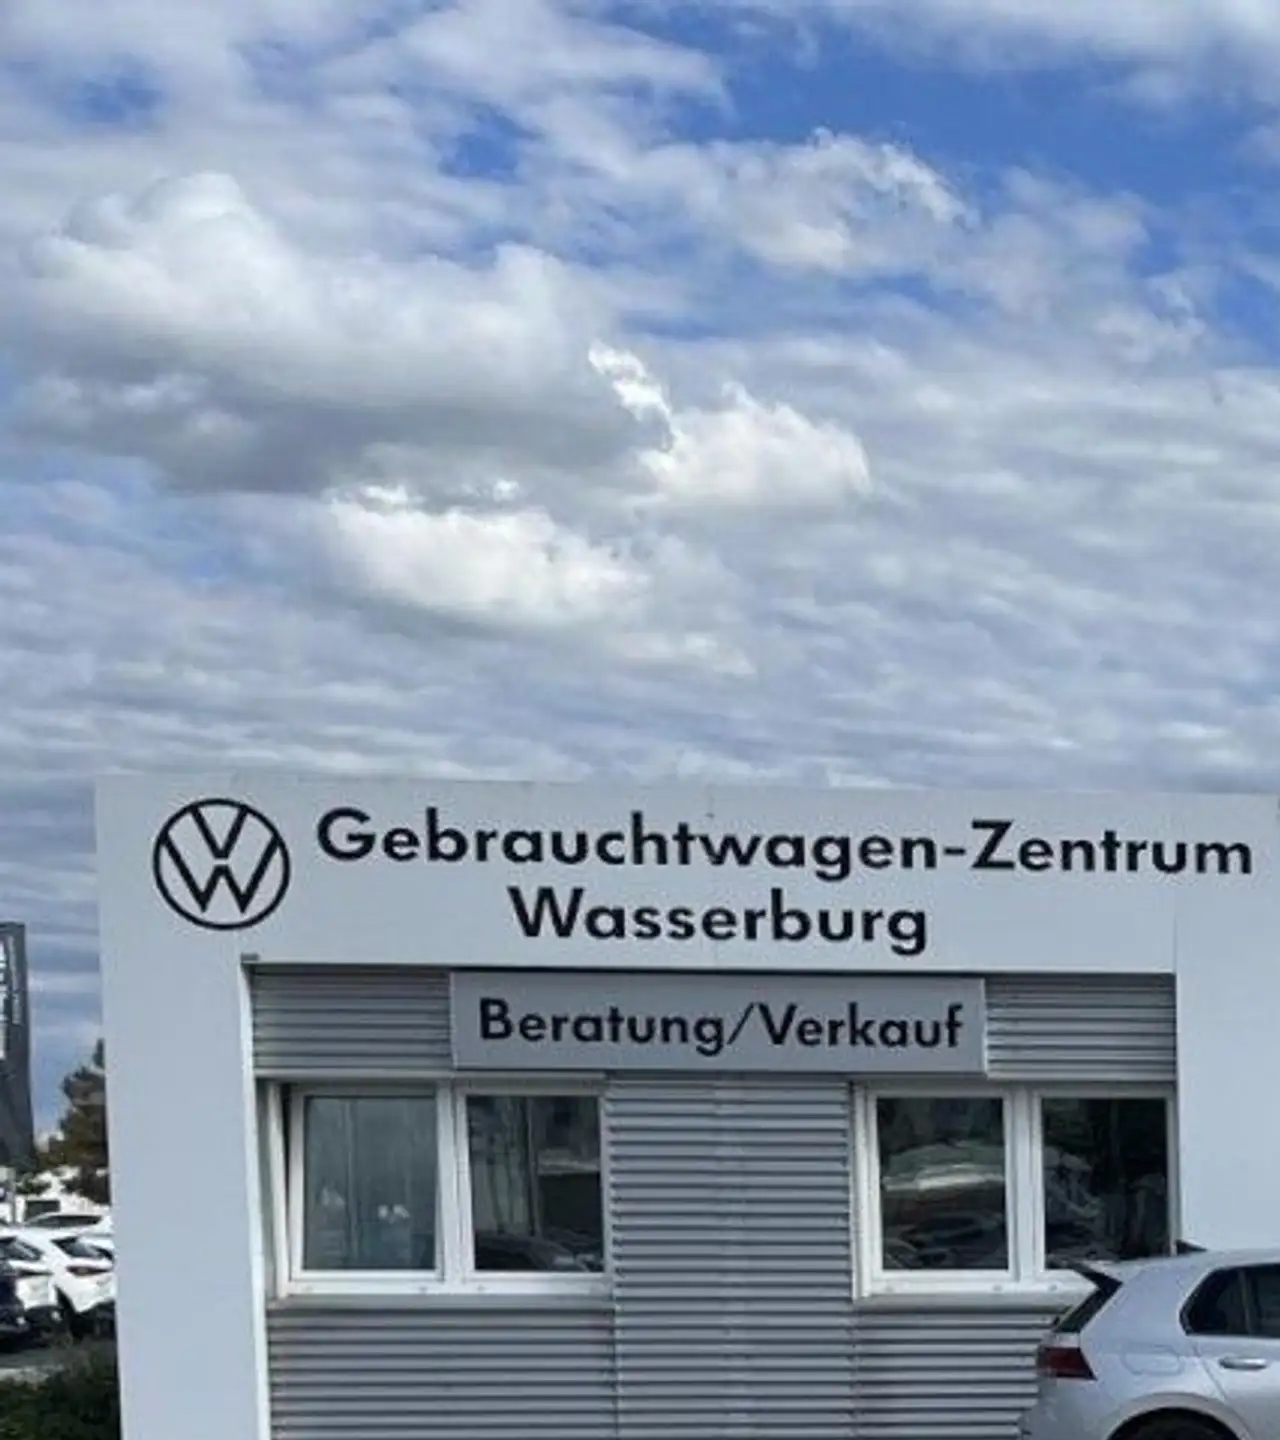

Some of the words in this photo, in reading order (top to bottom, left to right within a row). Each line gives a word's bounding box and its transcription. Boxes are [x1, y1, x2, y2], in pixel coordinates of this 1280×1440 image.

[317, 806, 1251, 882] Gebrauchtwagen-Zentrum
[507, 886, 926, 956] Wasserburg
[478, 996, 964, 1058] Beratung/Verkauf
